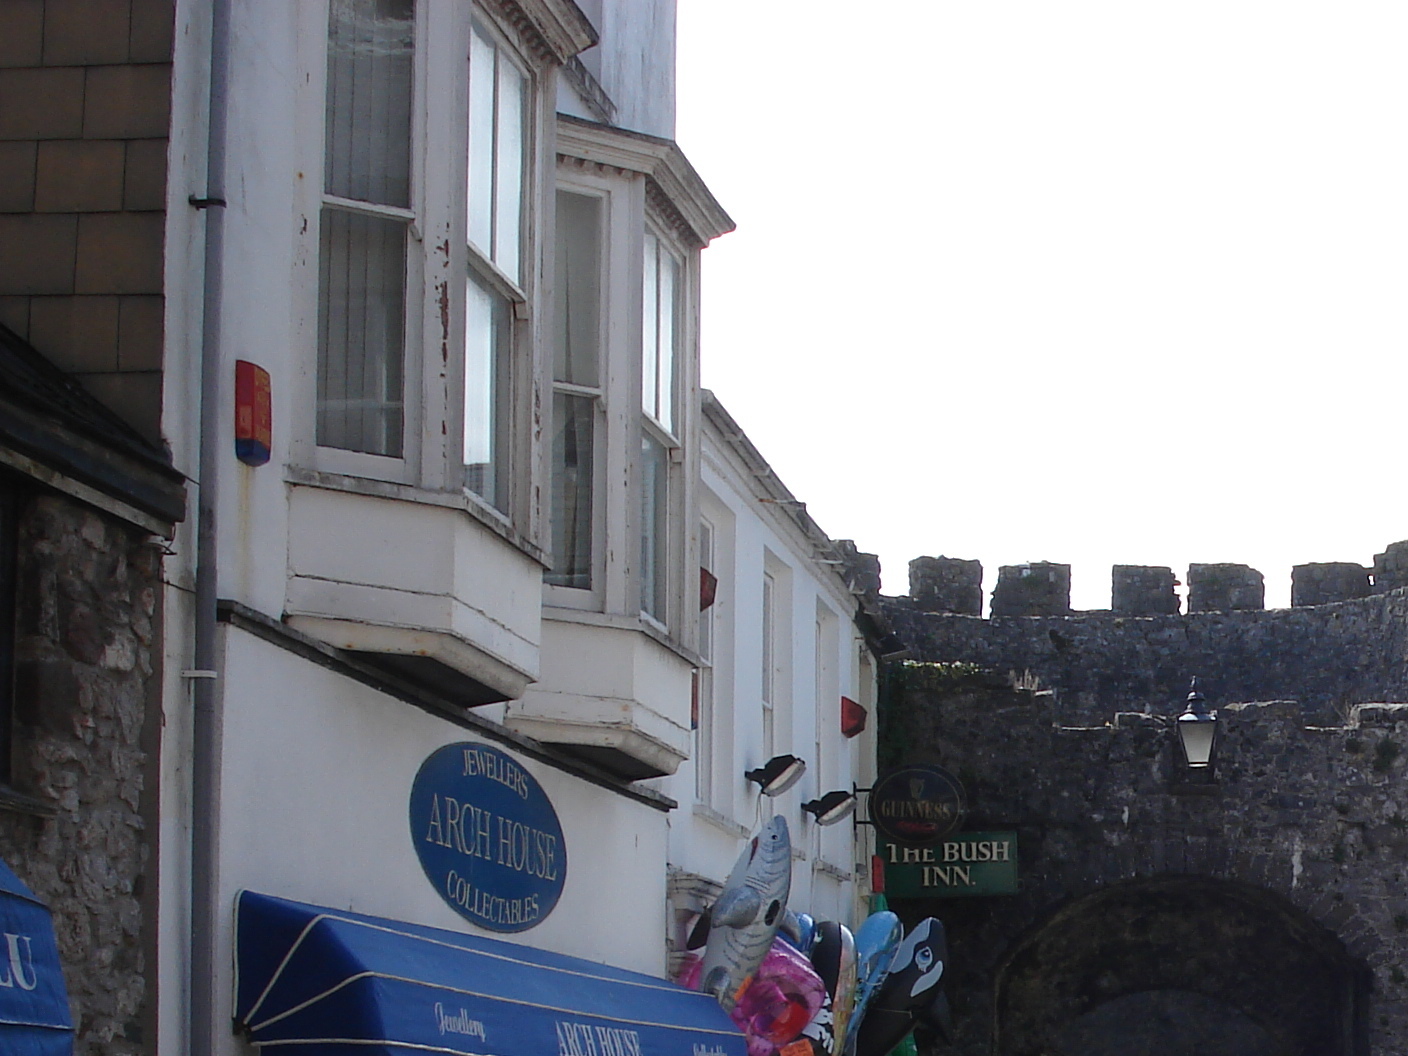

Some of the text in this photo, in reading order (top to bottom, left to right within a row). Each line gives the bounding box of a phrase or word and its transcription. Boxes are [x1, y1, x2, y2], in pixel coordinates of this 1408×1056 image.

[463, 749, 528, 800] JEWELLERS
[882, 800, 951, 819] GUINNESS
[426, 793, 557, 881] ARCH HOUSE
[886, 841, 1010, 863] THE BUSH
[447, 870, 539, 925] COLLECTABLES
[435, 1002, 486, 1042] Jewellery
